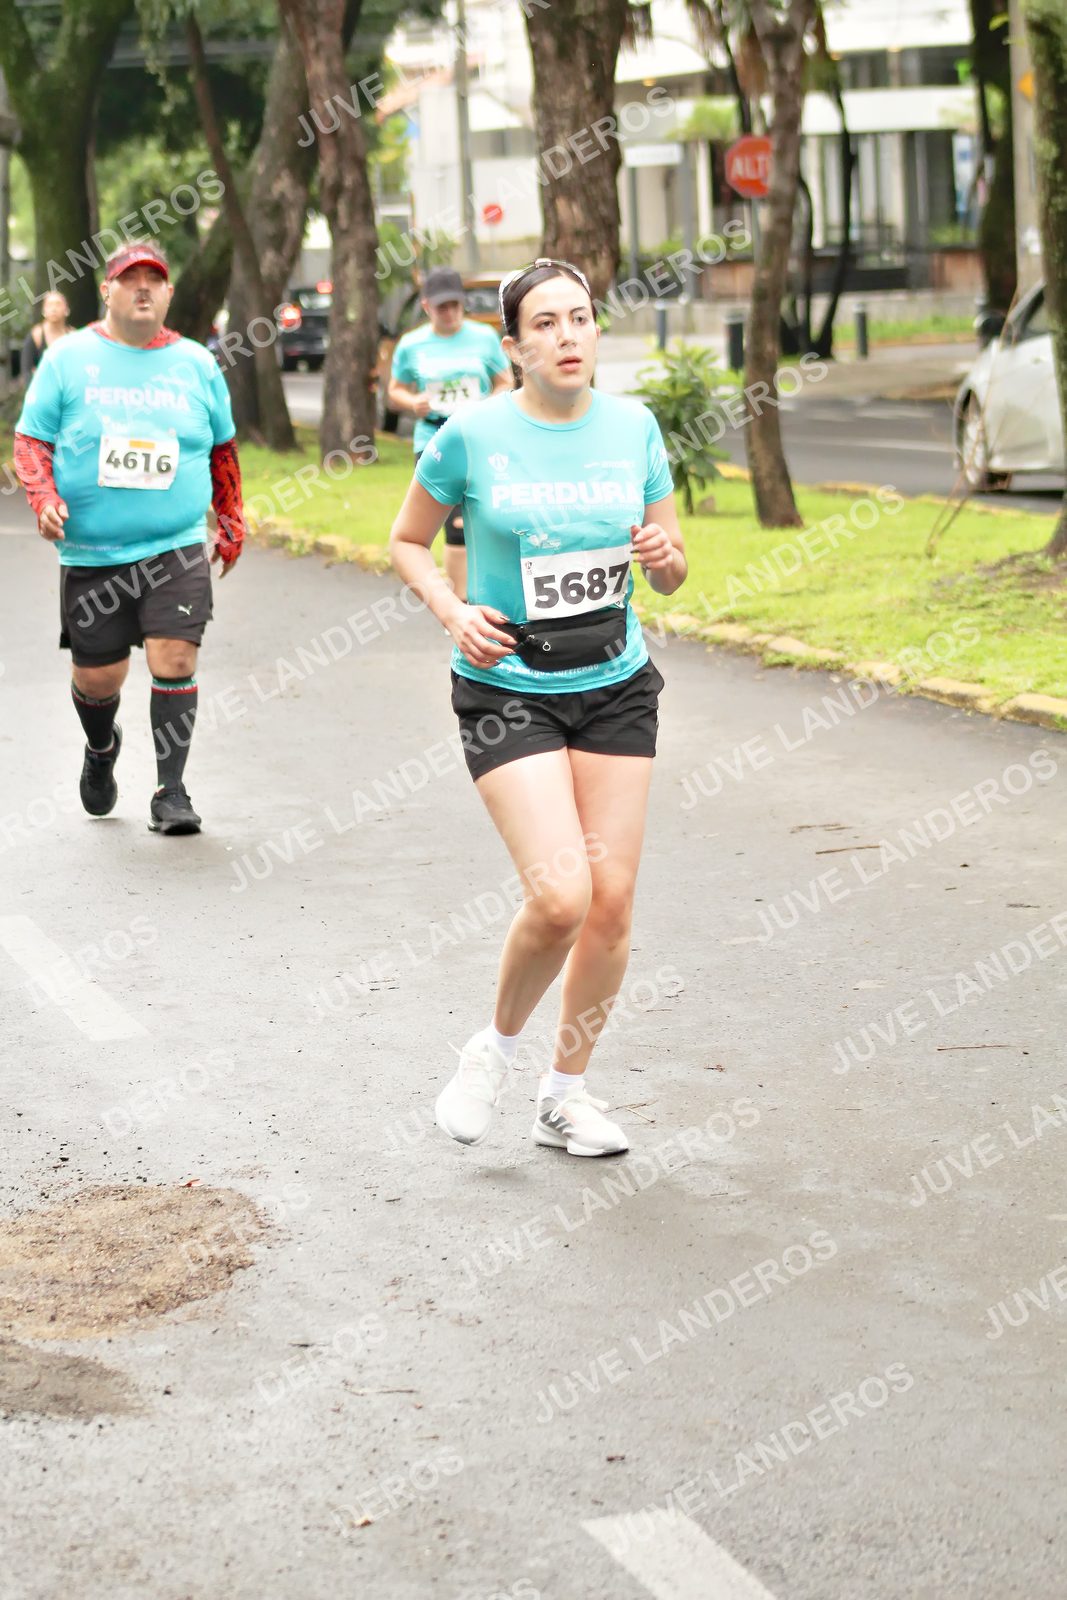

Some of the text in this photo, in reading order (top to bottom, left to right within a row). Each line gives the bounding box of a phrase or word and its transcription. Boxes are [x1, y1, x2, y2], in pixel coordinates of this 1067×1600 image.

[732, 155, 770, 180] ALT
[106, 450, 172, 474] 4616
[533, 560, 630, 609] 5687
